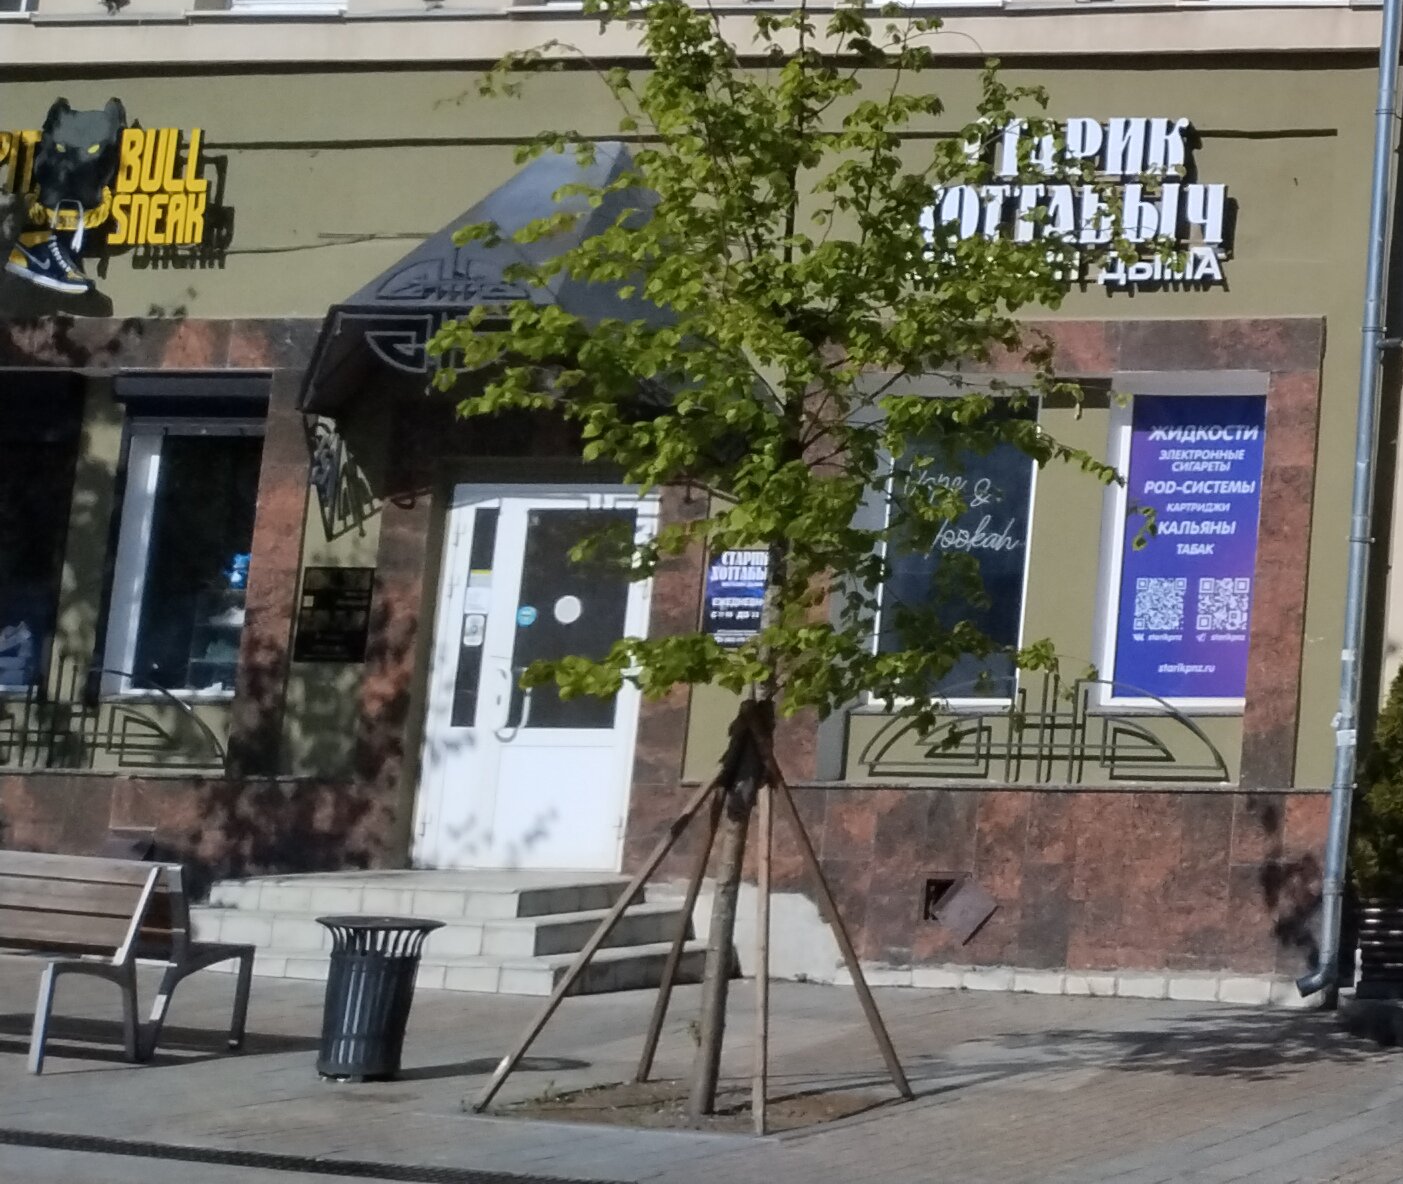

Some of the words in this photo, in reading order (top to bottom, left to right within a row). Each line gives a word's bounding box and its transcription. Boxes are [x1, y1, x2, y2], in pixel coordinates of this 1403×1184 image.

[116, 127, 208, 193] BULL
[107, 193, 207, 245] SNEAK
[1148, 424, 1260, 443] ЖИДКОСТИ
[1158, 449, 1246, 460] ЭЛЕКТРОННЫЕ
[1171, 461, 1232, 472] СИГАРЕТЫ
[1143, 480, 1256, 495] POD-СИСТЕМЫ
[1166, 502, 1232, 513] КАРТРИДЖИ
[1157, 520, 1237, 535] КАЛЬЯНЫ
[1176, 543, 1215, 555] ТАБАК
